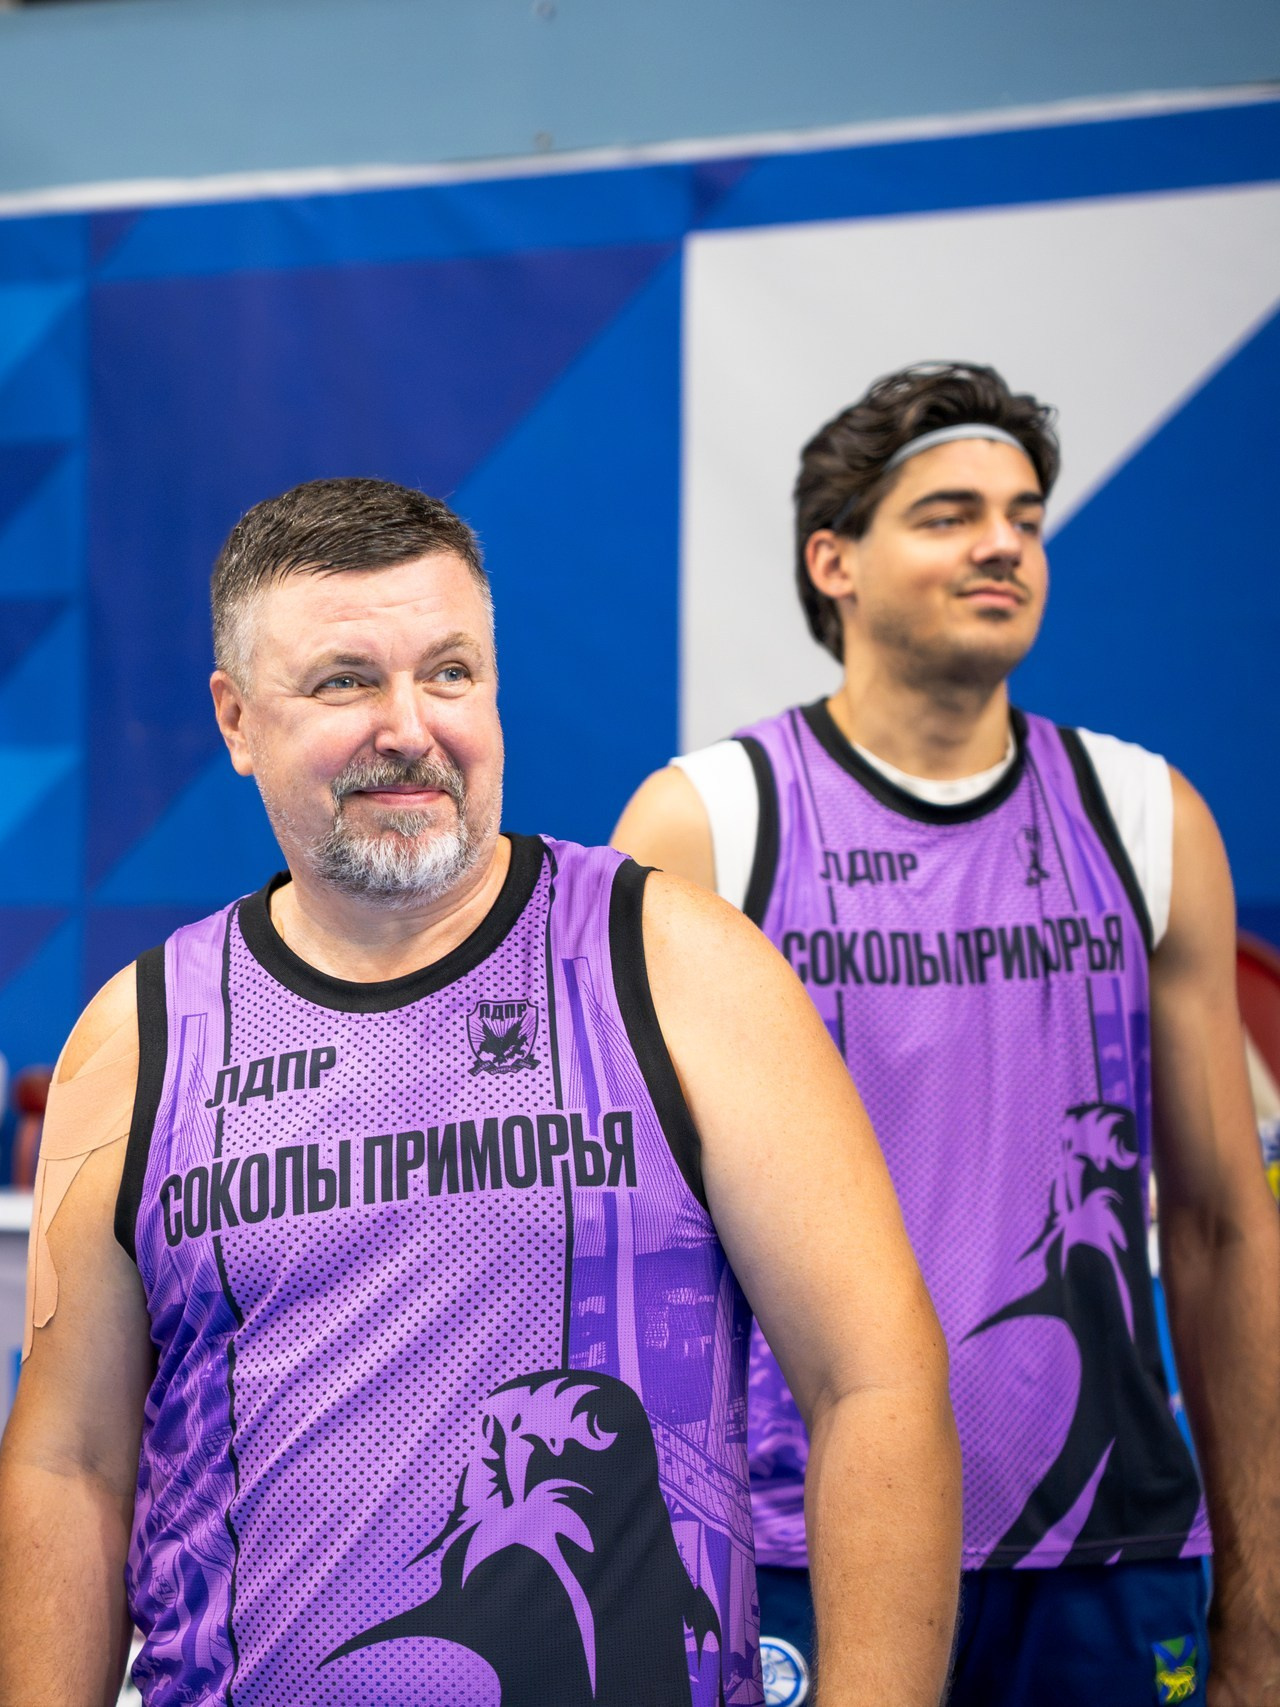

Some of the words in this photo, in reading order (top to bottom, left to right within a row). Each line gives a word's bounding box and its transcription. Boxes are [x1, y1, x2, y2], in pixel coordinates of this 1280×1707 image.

[820, 849, 918, 887] ЛДПР
[782, 929, 952, 987] СОКОЛЫ
[478, 1003, 527, 1022] ЛДПР
[205, 1046, 337, 1109] ЛДПР
[159, 1140, 351, 1247] СОКОЛЫ
[362, 1111, 637, 1205] ПРИМОРЬЯ
